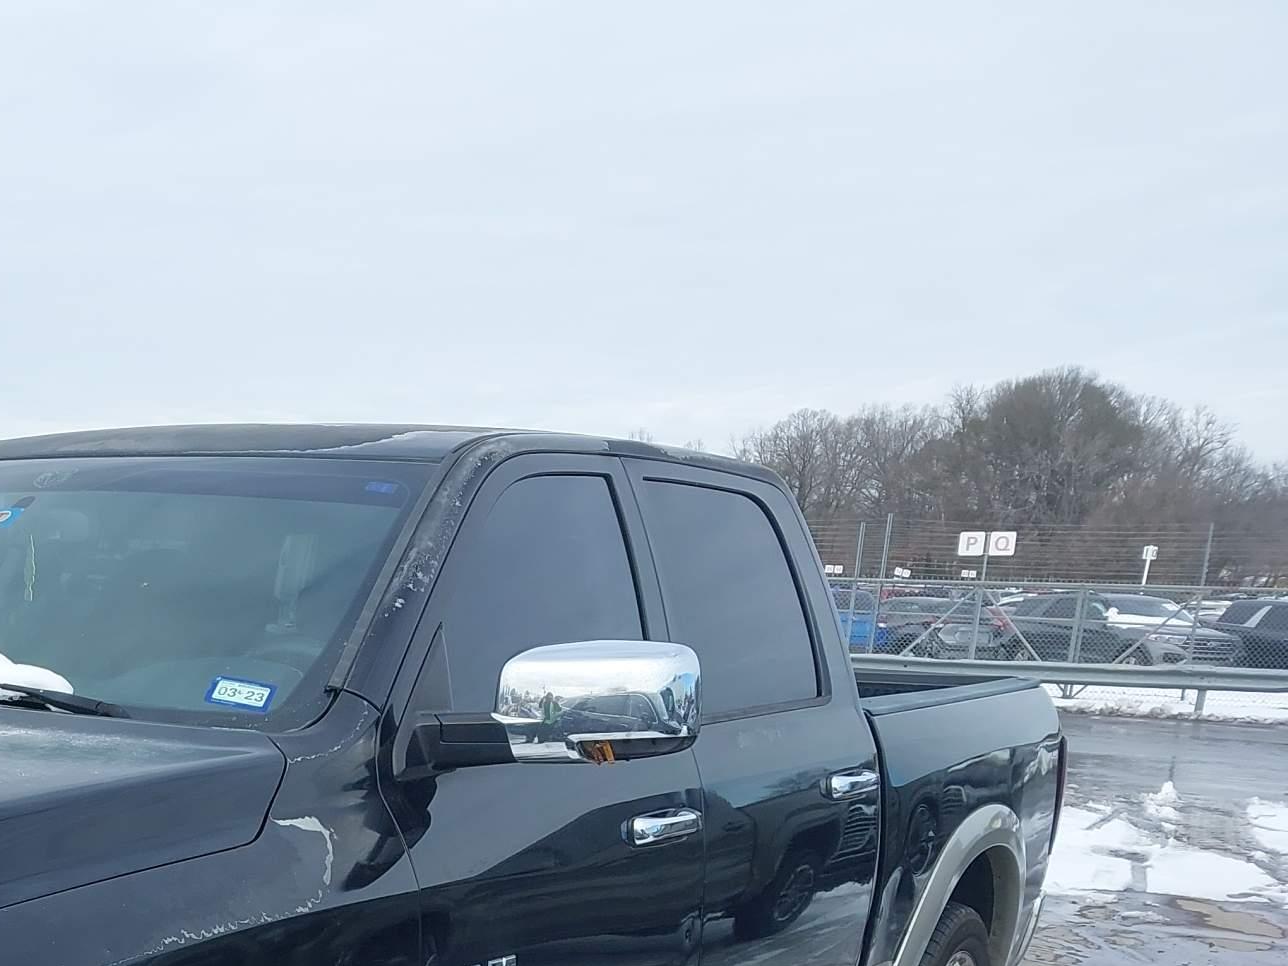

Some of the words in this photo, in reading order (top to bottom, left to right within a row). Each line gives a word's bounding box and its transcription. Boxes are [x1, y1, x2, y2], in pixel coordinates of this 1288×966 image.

[965, 536, 978, 551] P
[994, 536, 1011, 551] Q
[217, 686, 238, 698] 03
[244, 690, 265, 702] 23
